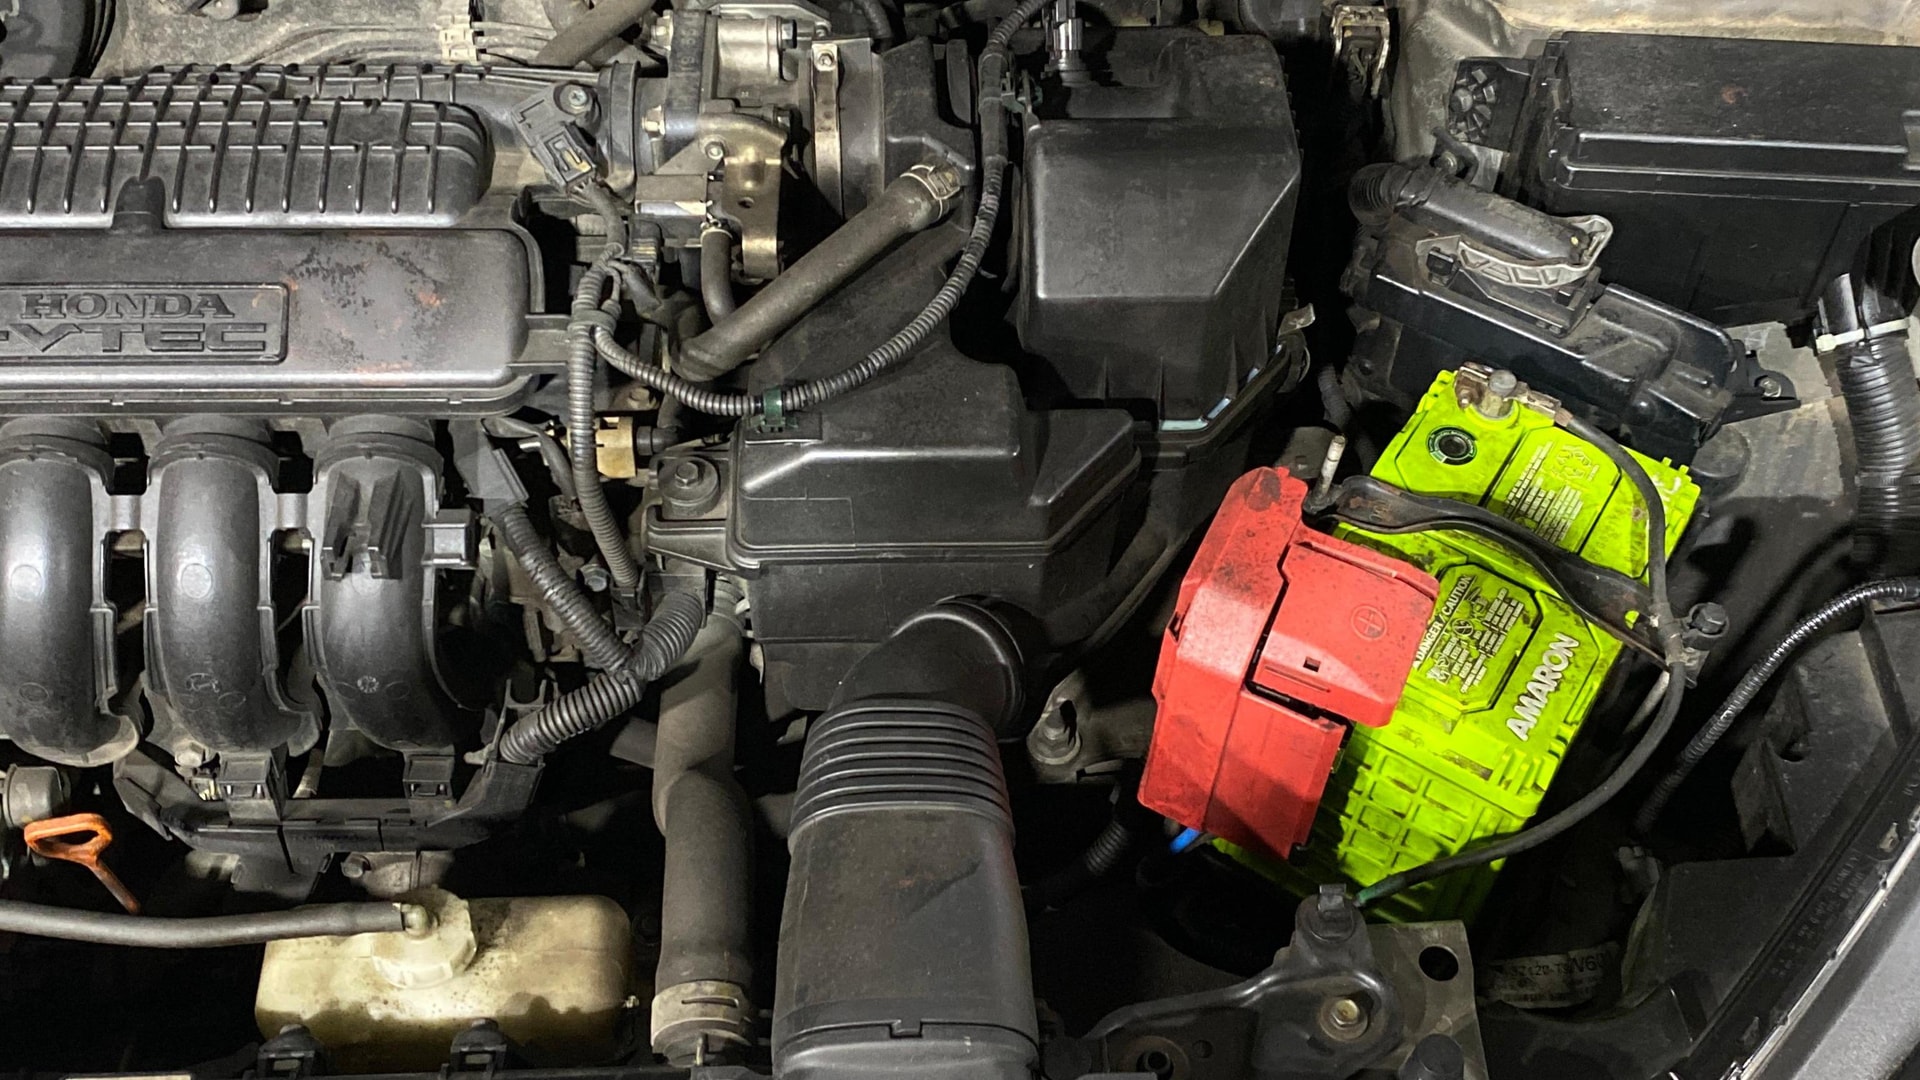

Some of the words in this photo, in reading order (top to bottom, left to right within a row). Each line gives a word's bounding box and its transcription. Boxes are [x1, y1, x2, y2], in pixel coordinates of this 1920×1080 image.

[20, 292, 235, 319] HONDA
[1416, 619, 1443, 662] DANGER
[1440, 573, 1473, 617] CAUTION
[1506, 631, 1580, 742] AMARON
